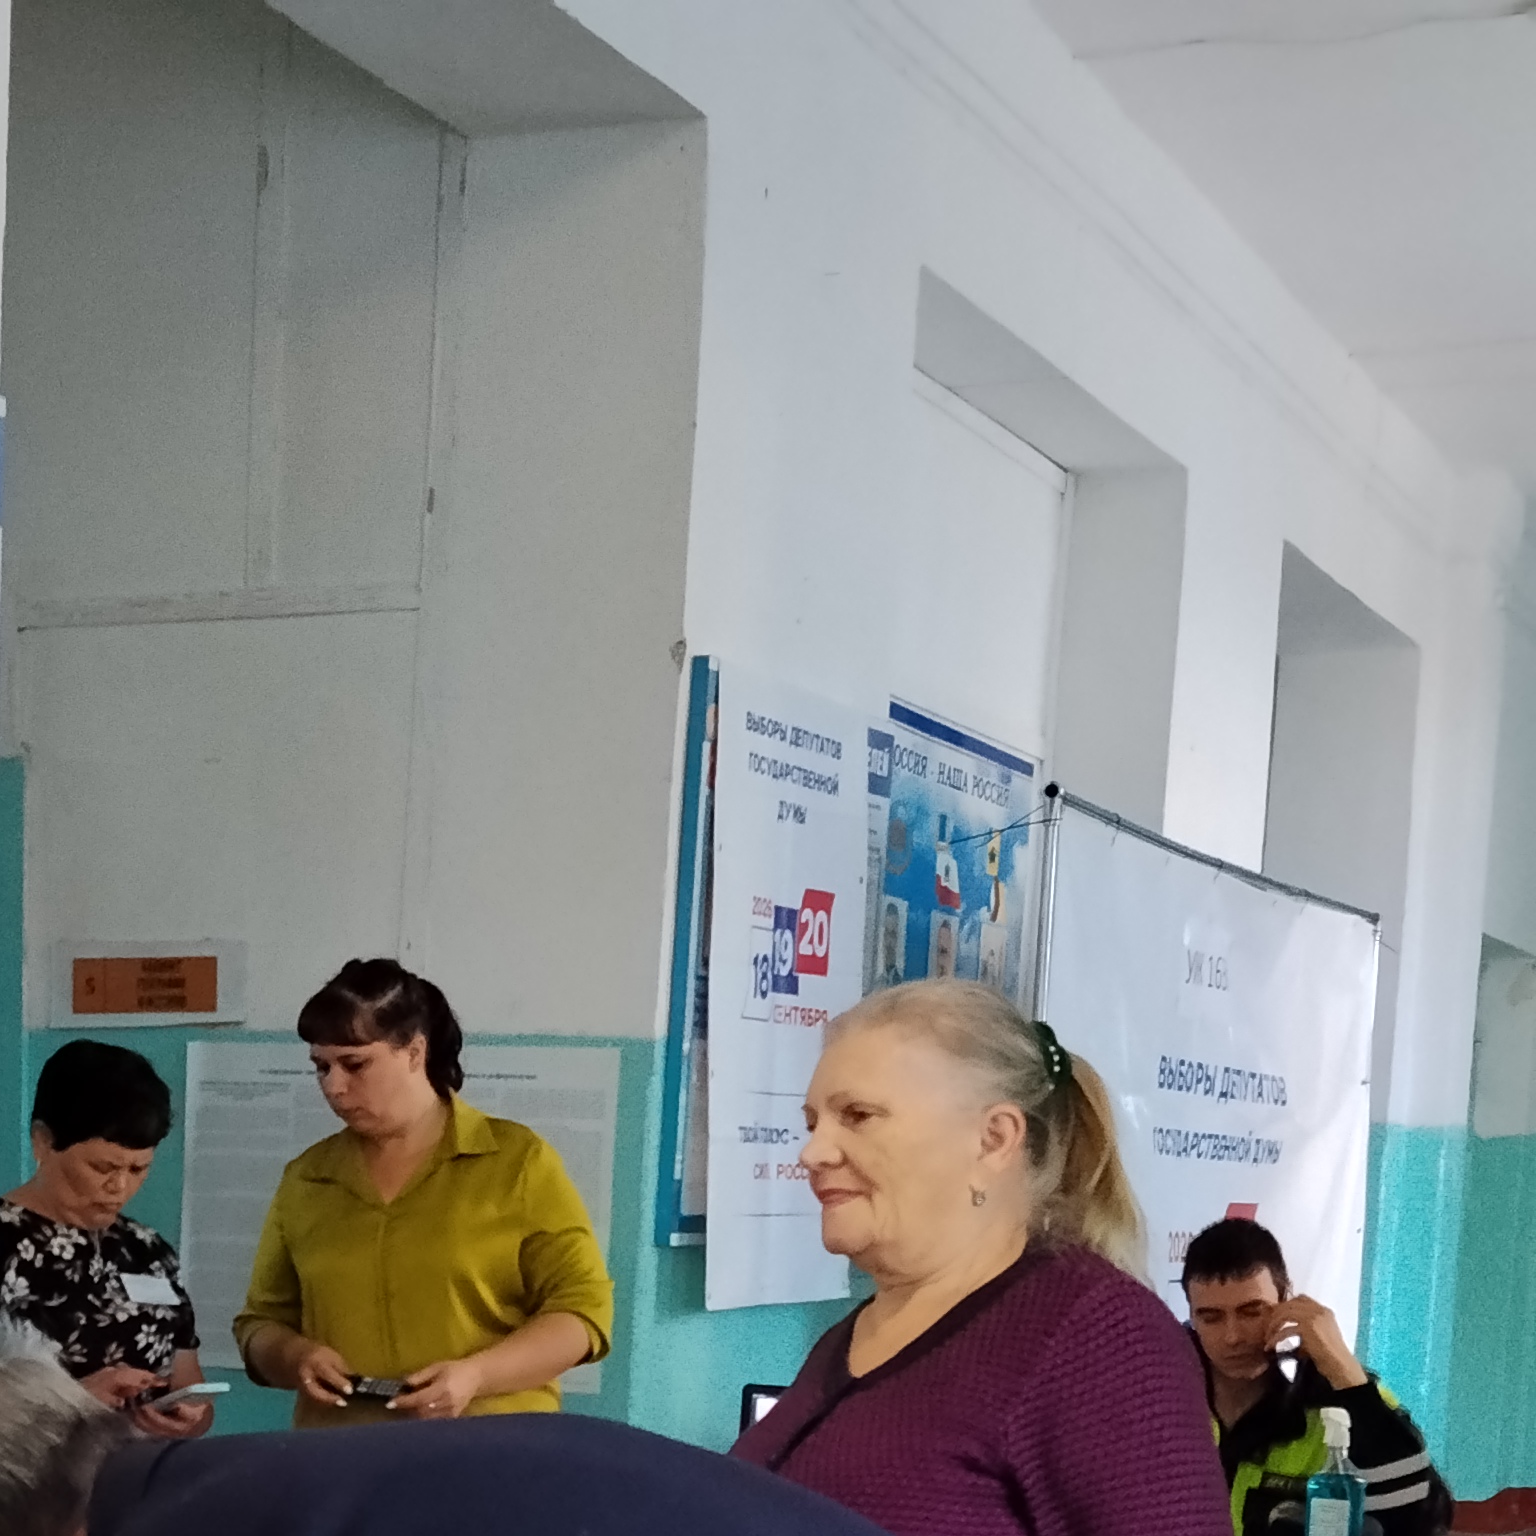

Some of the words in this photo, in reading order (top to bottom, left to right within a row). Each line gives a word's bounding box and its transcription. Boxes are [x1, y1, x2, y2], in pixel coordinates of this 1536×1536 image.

[746, 710, 788, 742] ВЫБОРЫ
[893, 743, 929, 779] ОССИЯ
[936, 762, 969, 794] НАША
[971, 774, 1011, 809] РОССИЯ
[774, 928, 794, 977] 19
[799, 907, 829, 958] 20
[752, 953, 770, 1000] 18
[1157, 1054, 1218, 1097] ВЫБОРЫ
[1217, 1066, 1287, 1107] ДЕПУТАТОВ
[776, 1162, 811, 1181] РОСС
[1168, 1231, 1194, 1264] 202
